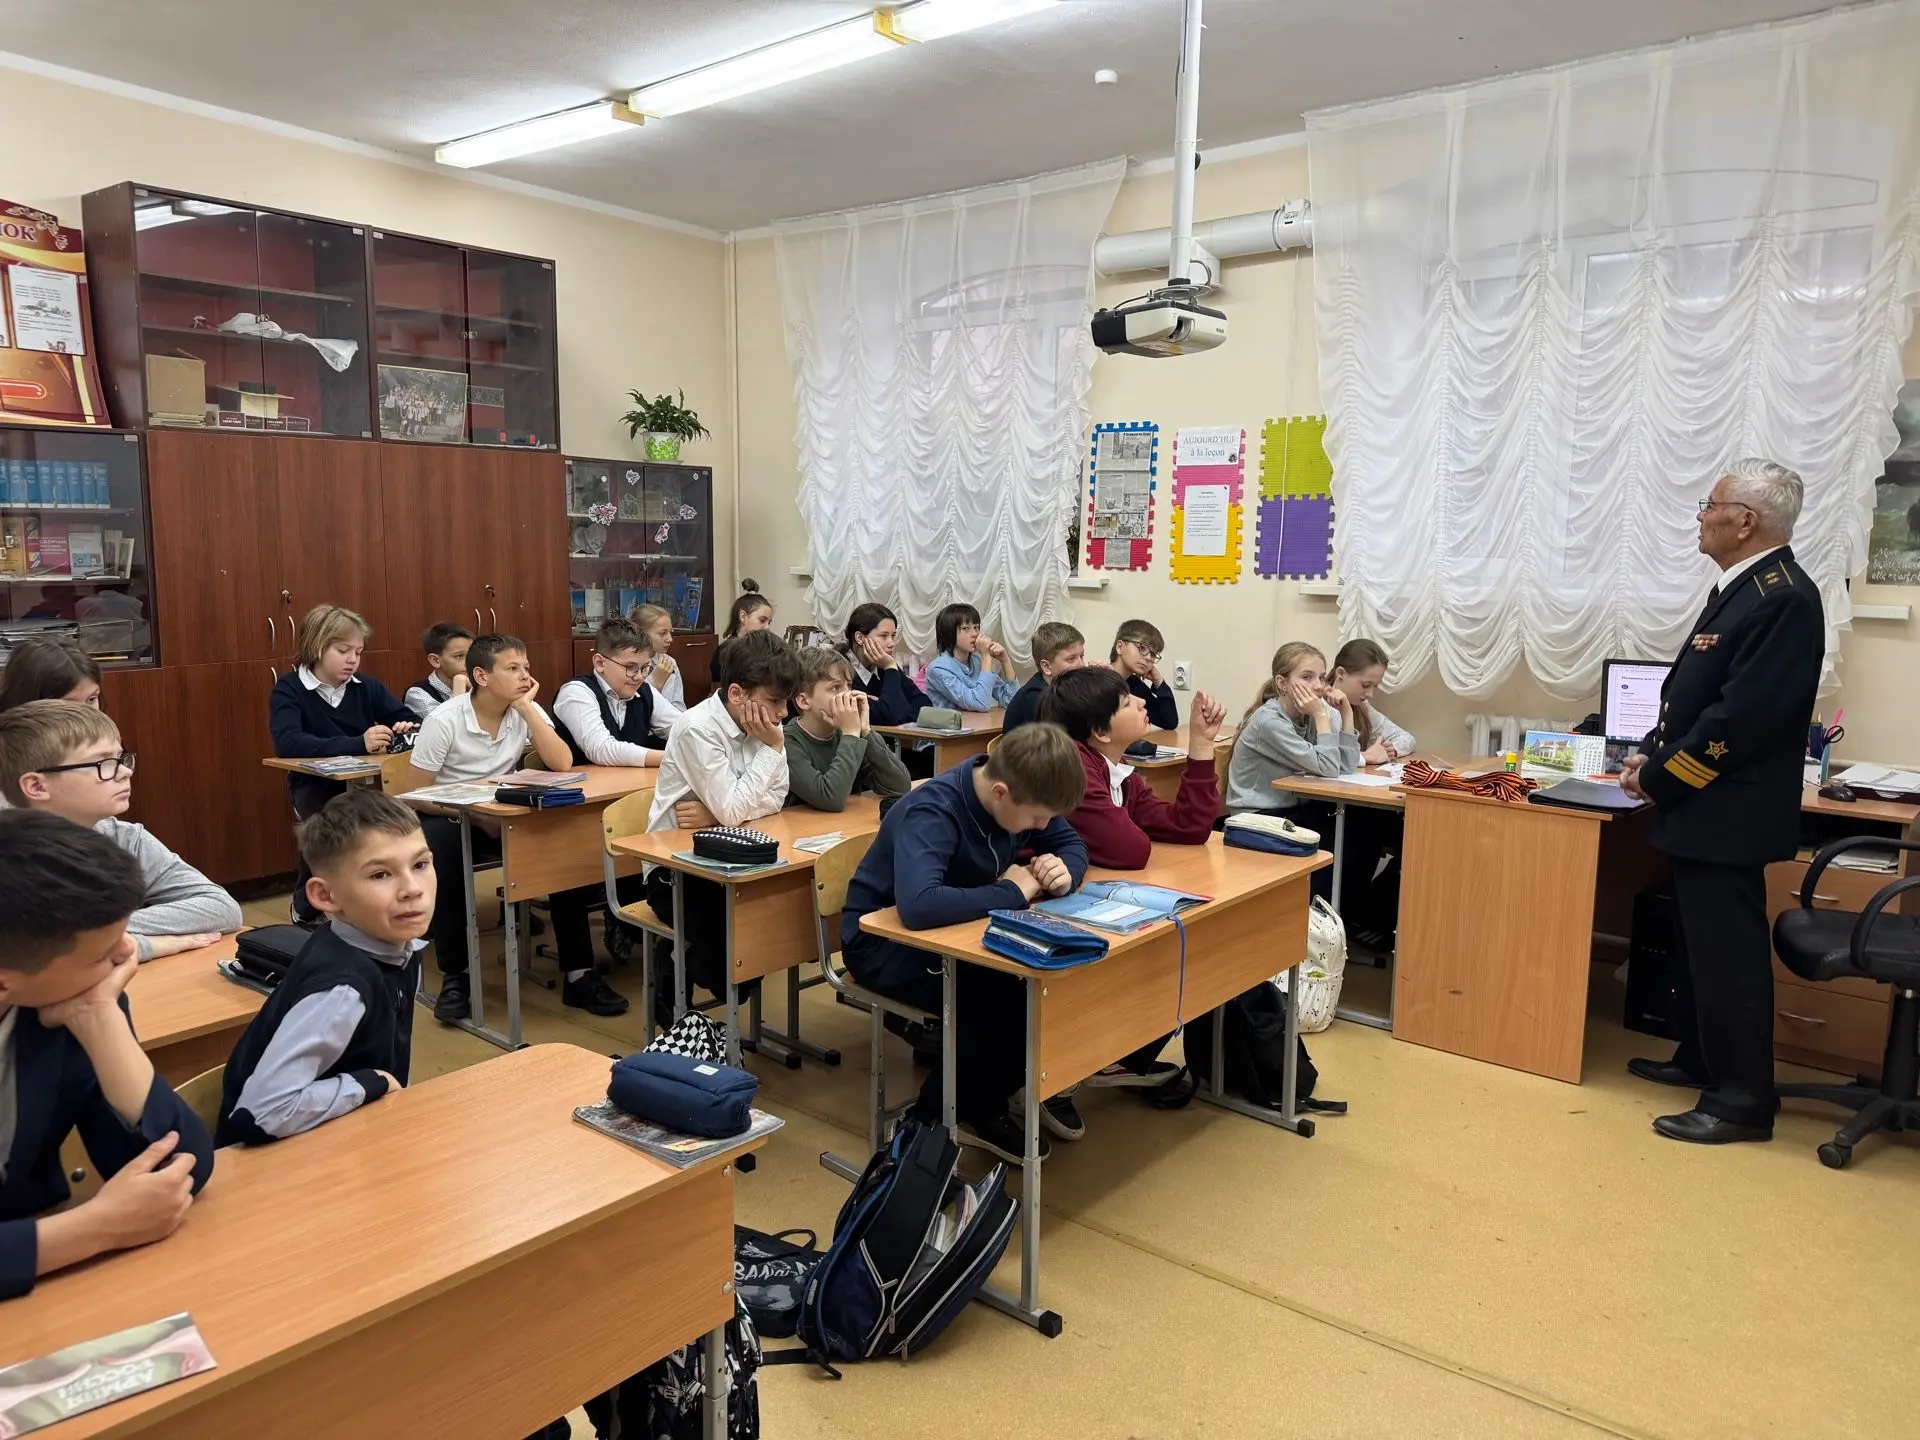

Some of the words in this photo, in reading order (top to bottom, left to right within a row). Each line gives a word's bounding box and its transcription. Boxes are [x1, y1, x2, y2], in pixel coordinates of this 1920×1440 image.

[0, 223, 35, 241] ОК
[1183, 435, 1234, 444] AUJOURD'HUI
[1197, 448, 1204, 456] la
[1205, 447, 1225, 458] leçon
